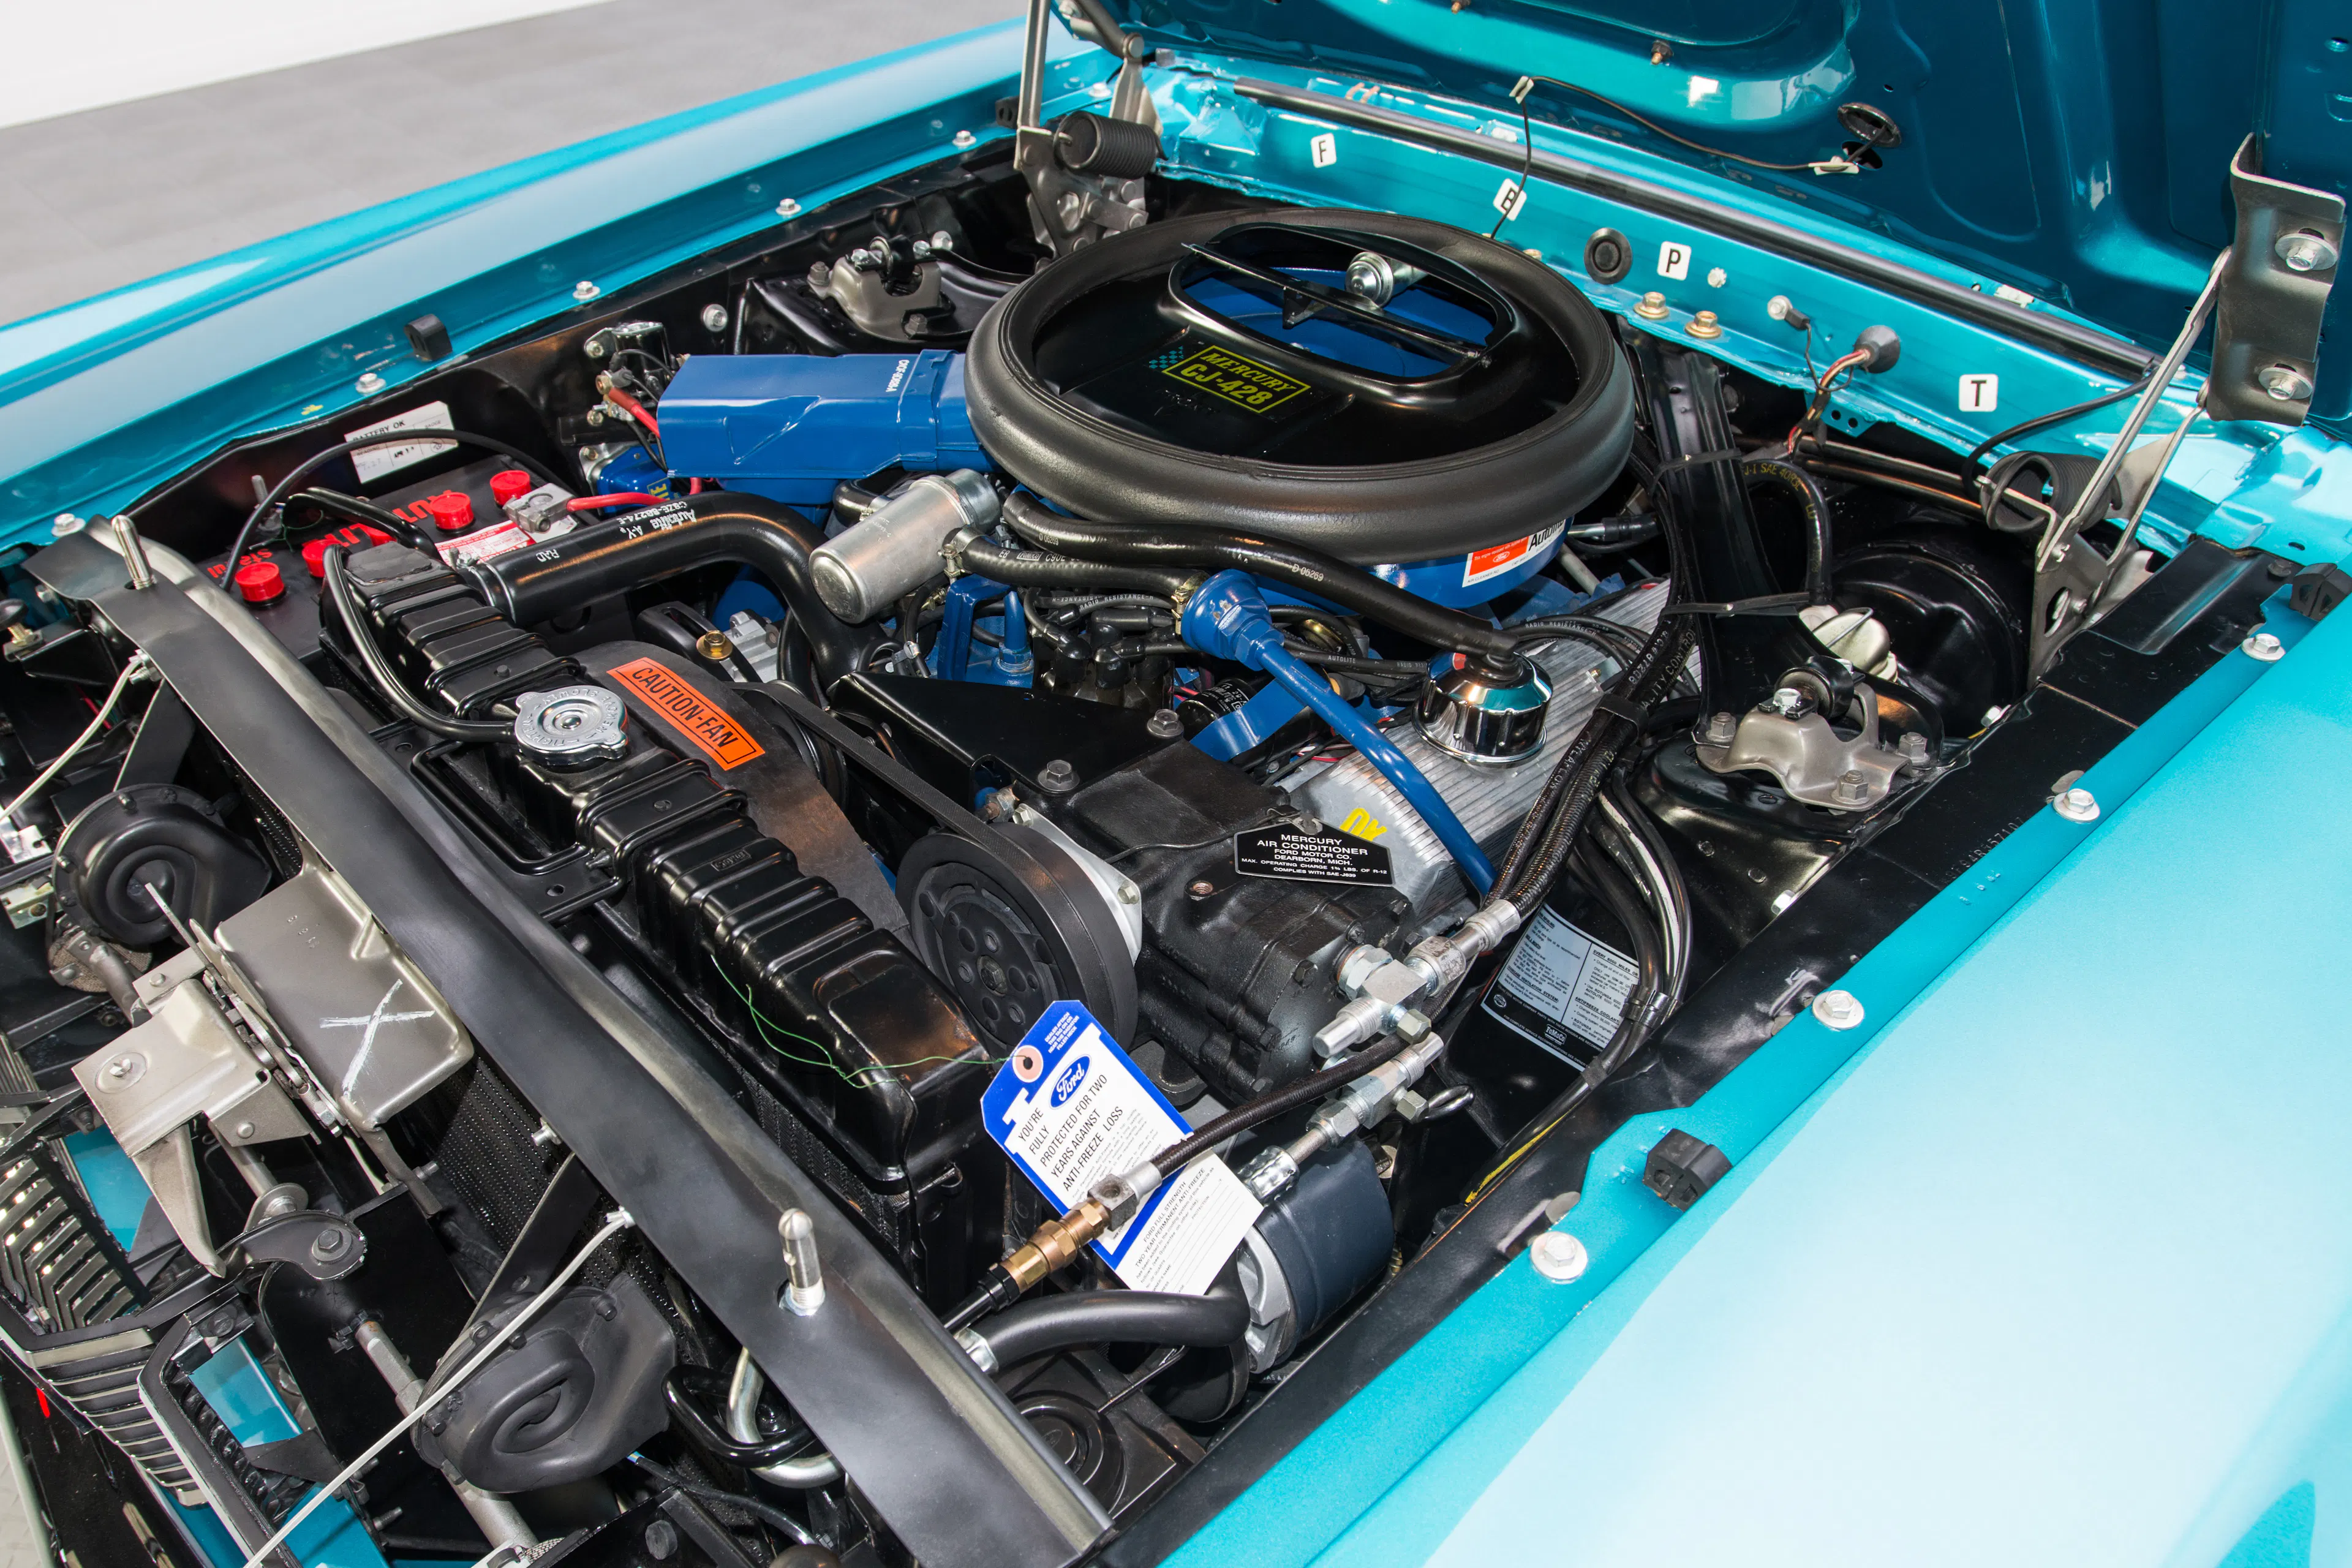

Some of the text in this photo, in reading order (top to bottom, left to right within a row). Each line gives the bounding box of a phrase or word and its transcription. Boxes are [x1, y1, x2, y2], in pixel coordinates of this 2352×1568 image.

[1319, 141, 1327, 161] F
[1501, 190, 1518, 210] B
[1668, 251, 1681, 273] P
[1200, 353, 1297, 391] MERCURY
[1181, 364, 1273, 404] CJ-428
[1971, 379, 1986, 407] T
[392, 419, 405, 429] OK
[1761, 463, 1777, 475] SAE
[1300, 567, 1324, 582] 06269
[1079, 598, 1099, 610] RADIO
[1328, 655, 1356, 663] AUTOLITE
[632, 667, 738, 748] CAUTION-FAN
[1340, 808, 1387, 842] OK
[1281, 834, 1343, 845] MERCURY
[1282, 842, 1368, 855] CONDITIONER
[1275, 854, 1325, 864] DEARBORN,
[1593, 949, 1606, 959] EVERY
[1618, 963, 1630, 973] MILES
[1596, 959, 1608, 969] Change
[1520, 976, 1542, 992] VENTILATION
[1591, 970, 1607, 981] peratures
[1575, 995, 1599, 1012] ANTIFREEZE
[1585, 987, 1603, 1000] AUTOLITE
[1594, 988, 1611, 1000] ROTUNDA
[1522, 1003, 1537, 1014] COMPANY
[1536, 1011, 1547, 1020] PARTS
[1578, 1005, 1591, 1014] Change
[1044, 1012, 1069, 1042] DEALER ATTACH
[1048, 1041, 1058, 1053] NEAR
[1062, 1015, 1079, 1035] RADIATOR
[1545, 1025, 1566, 1042] FoMoCo
[1573, 1017, 1592, 1031] ROTUNDA
[1575, 1011, 1588, 1020] Cooling
[1598, 1024, 1612, 1035] originally
[1048, 1035, 1057, 1045] THIS
[1056, 1025, 1077, 1050] FILLER NECK
[1050, 1059, 1088, 1103] Ford
[1018, 1107, 1043, 1141] YOU'RE
[1040, 1074, 1107, 1167] PROTECTED FOR TWO
[1028, 1125, 1049, 1154] FULLY
[1050, 1147, 1074, 1177] YEARS
[1071, 1108, 1099, 1149] AGAINST
[1063, 1132, 1103, 1191] ANTI-FREEZE
[1102, 1106, 1122, 1131] LOSS
[1135, 1167, 1204, 1267] TWO YEAR PERMANENT ANTI-FREEZE
[1143, 1182, 1186, 1242] FORD FULL STRENGTH
[1191, 1194, 1210, 1220] PROTECTION
[1140, 1257, 1151, 1272] been
[1148, 1244, 1160, 1259] added
[1166, 1215, 1180, 1233] cooling
[1177, 1200, 1191, 1216] system
[1191, 1186, 1200, 1196] this
[1197, 1171, 1211, 1188] vehicle
[1139, 1266, 1153, 1284] follows
[1158, 1231, 1177, 1256] Guarantee
[1180, 1210, 1190, 1224] other
